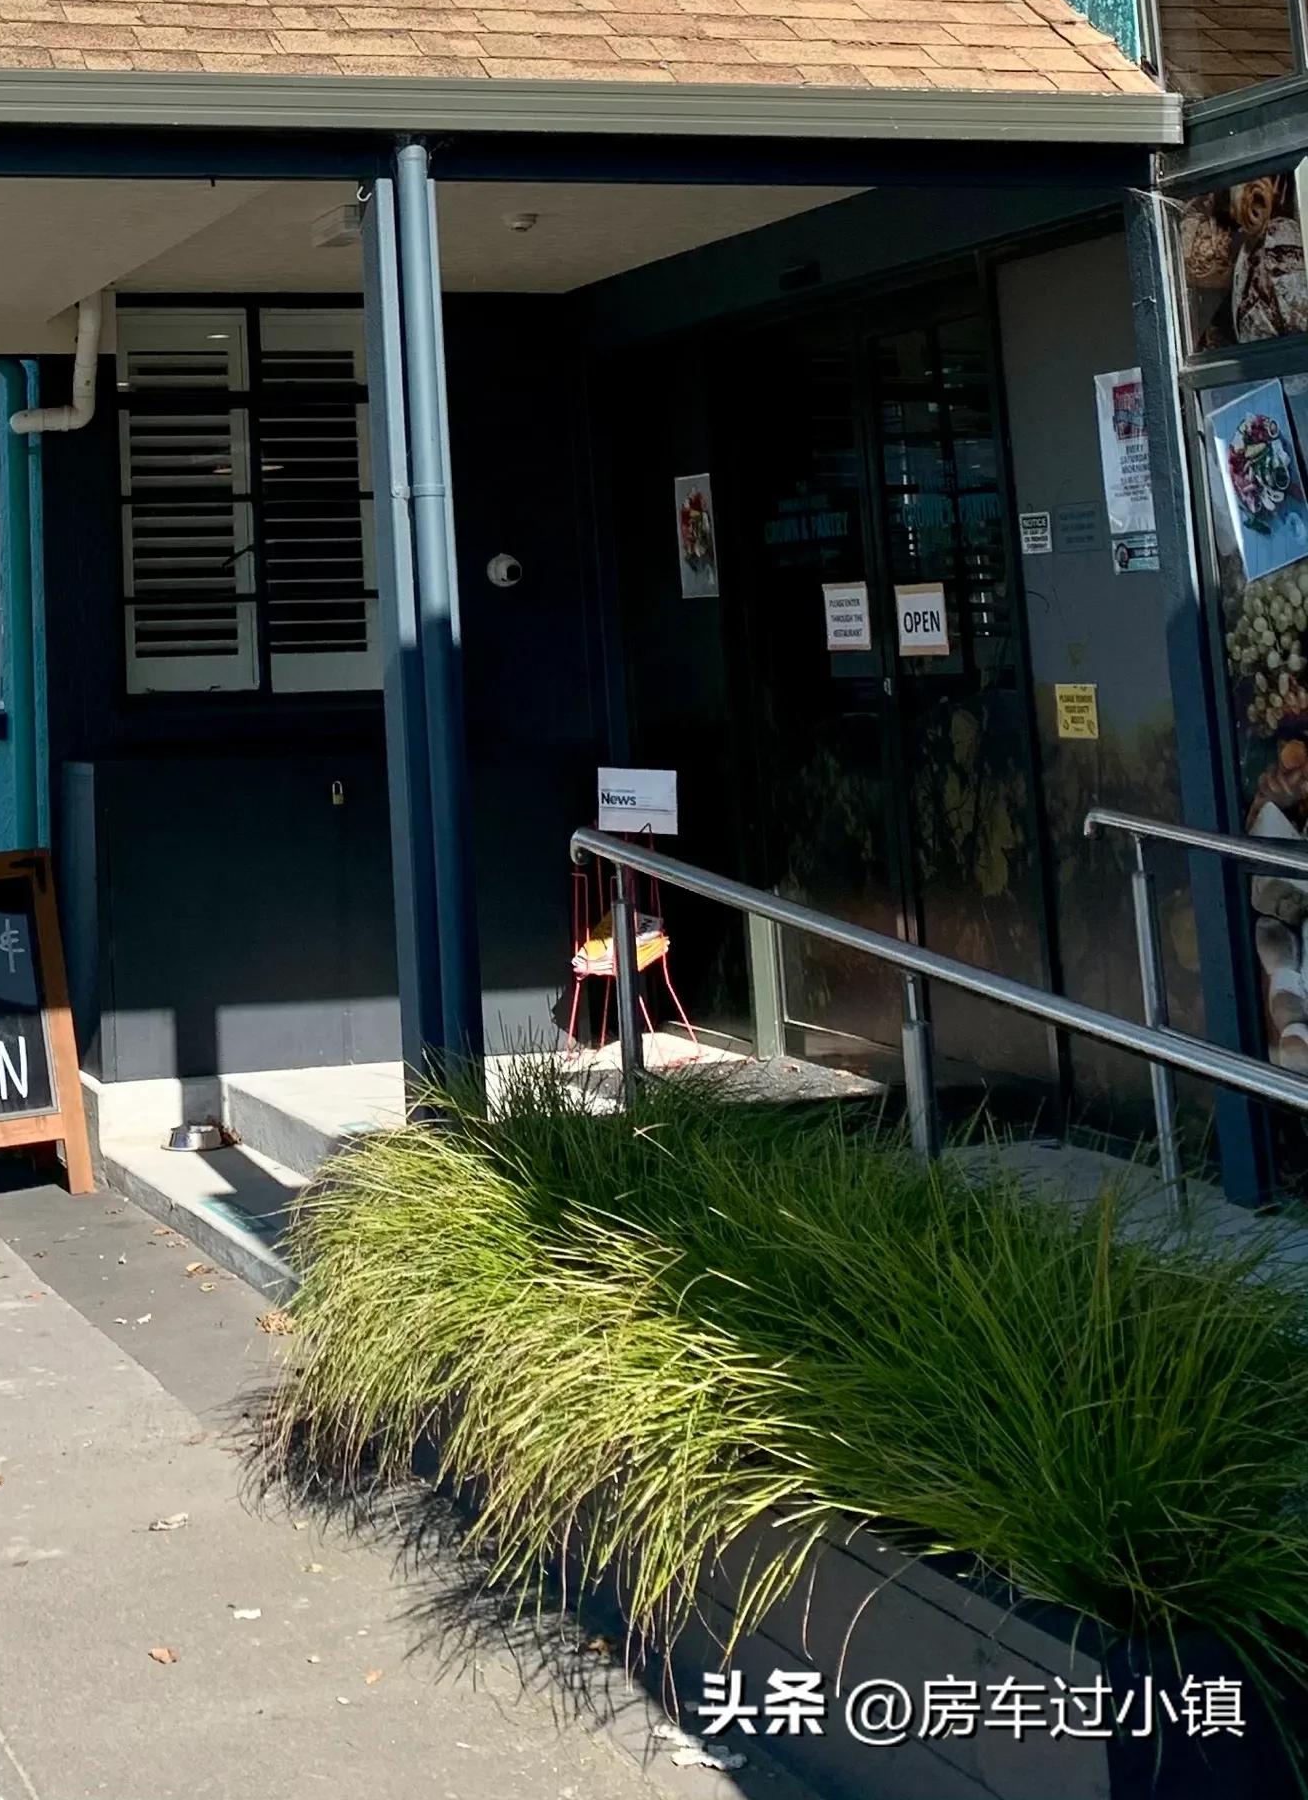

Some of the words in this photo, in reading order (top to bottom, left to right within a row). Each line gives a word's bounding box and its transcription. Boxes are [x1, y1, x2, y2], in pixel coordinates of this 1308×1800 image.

[1022, 517, 1048, 528] NOTICE
[903, 610, 941, 634] OPEN
[601, 791, 637, 806] News
